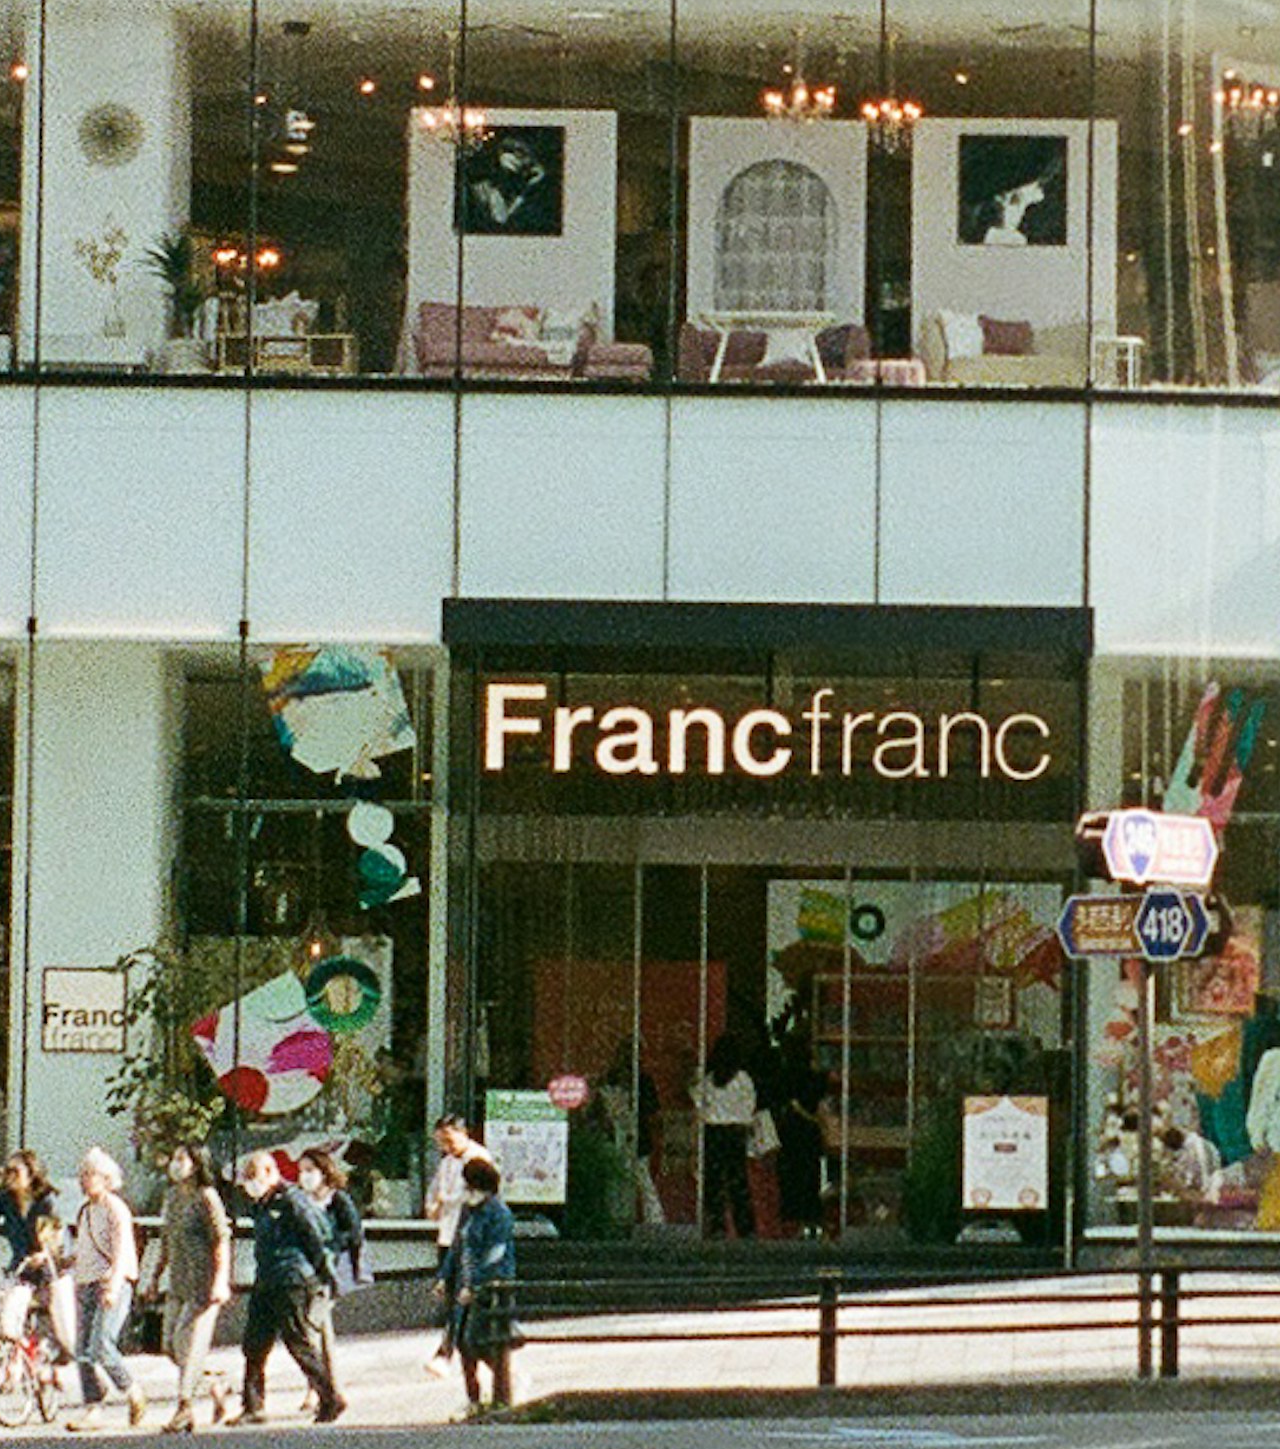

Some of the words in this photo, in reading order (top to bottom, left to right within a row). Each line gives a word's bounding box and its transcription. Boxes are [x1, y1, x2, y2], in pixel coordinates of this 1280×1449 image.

[484, 682, 1051, 779] Francfranc
[1143, 905, 1184, 943] 418
[42, 1002, 127, 1026] Franc
